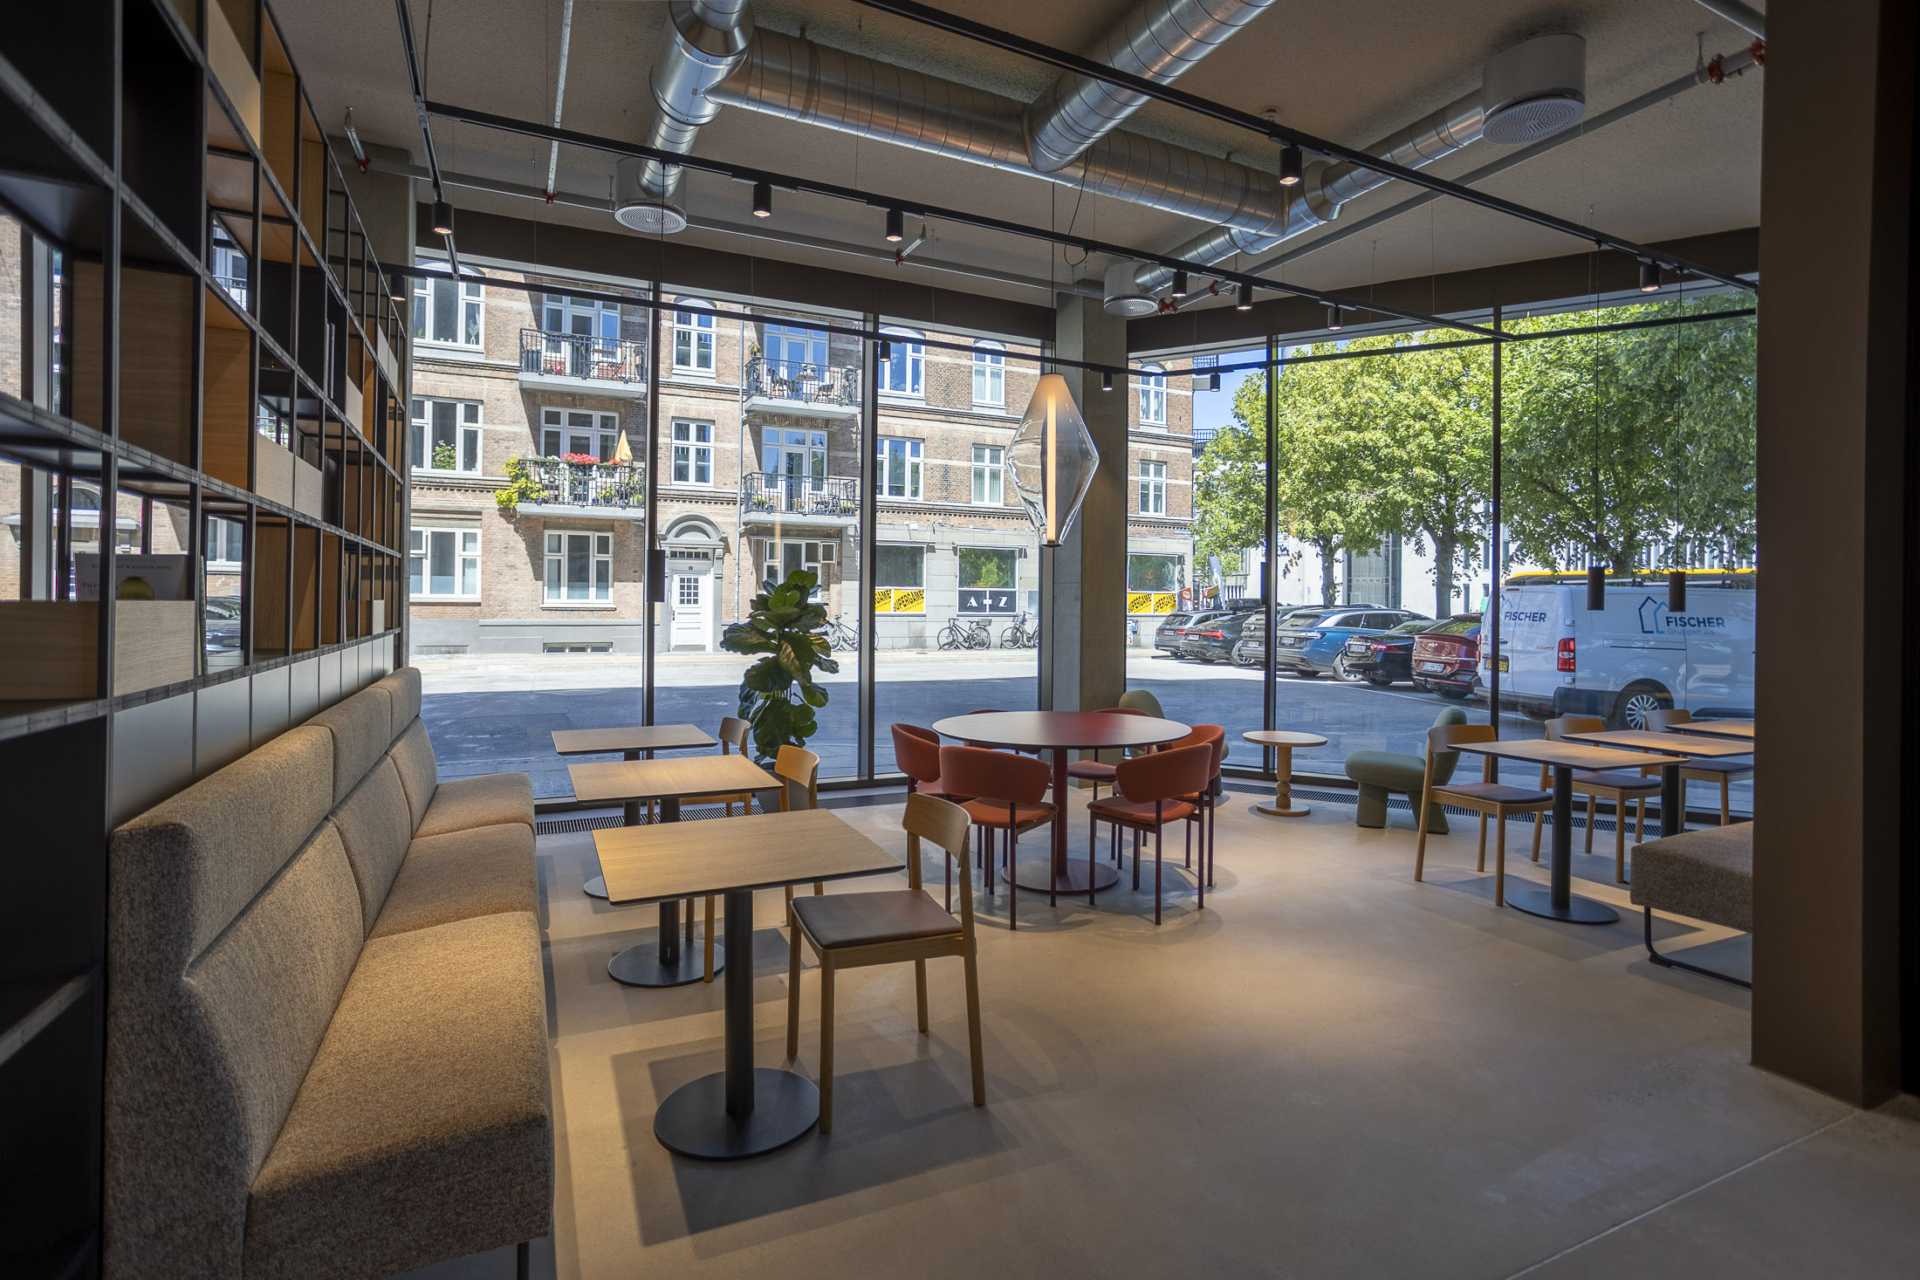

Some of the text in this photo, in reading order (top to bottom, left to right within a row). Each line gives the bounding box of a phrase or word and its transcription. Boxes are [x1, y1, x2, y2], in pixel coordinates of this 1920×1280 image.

[1504, 611, 1547, 622] FISCHER
[1665, 616, 1725, 628] FISCHER
[1667, 628, 1702, 636] Gruppen
